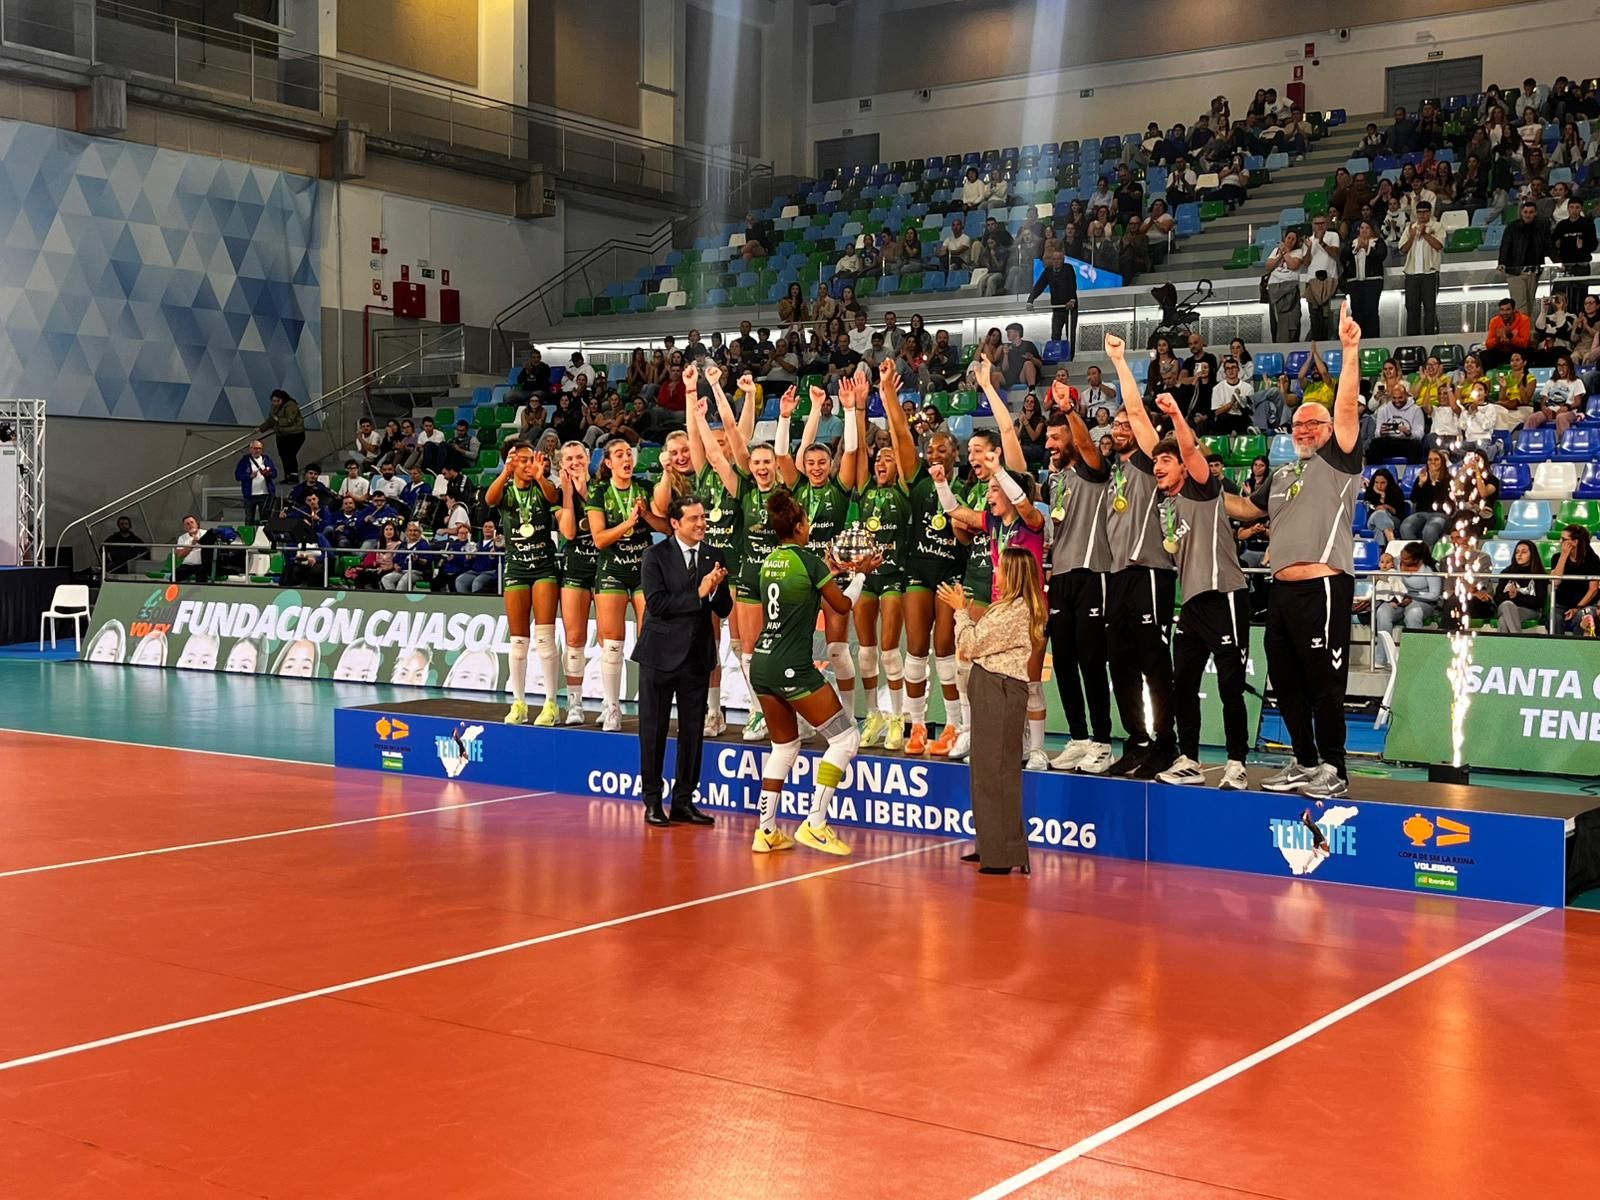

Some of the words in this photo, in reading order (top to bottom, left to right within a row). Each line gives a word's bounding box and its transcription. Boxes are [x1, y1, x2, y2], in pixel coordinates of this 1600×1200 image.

[171, 597, 361, 645] FUNDACIÓN
[364, 609, 512, 656] CAJASOL
[767, 583, 780, 620] 8
[1465, 665, 1582, 699] SANTA
[718, 748, 929, 798] CAPONAS
[588, 771, 643, 798] COPA
[781, 790, 857, 822] RENA
[866, 799, 977, 836] IBERDRO
[1028, 817, 1097, 849] 2026
